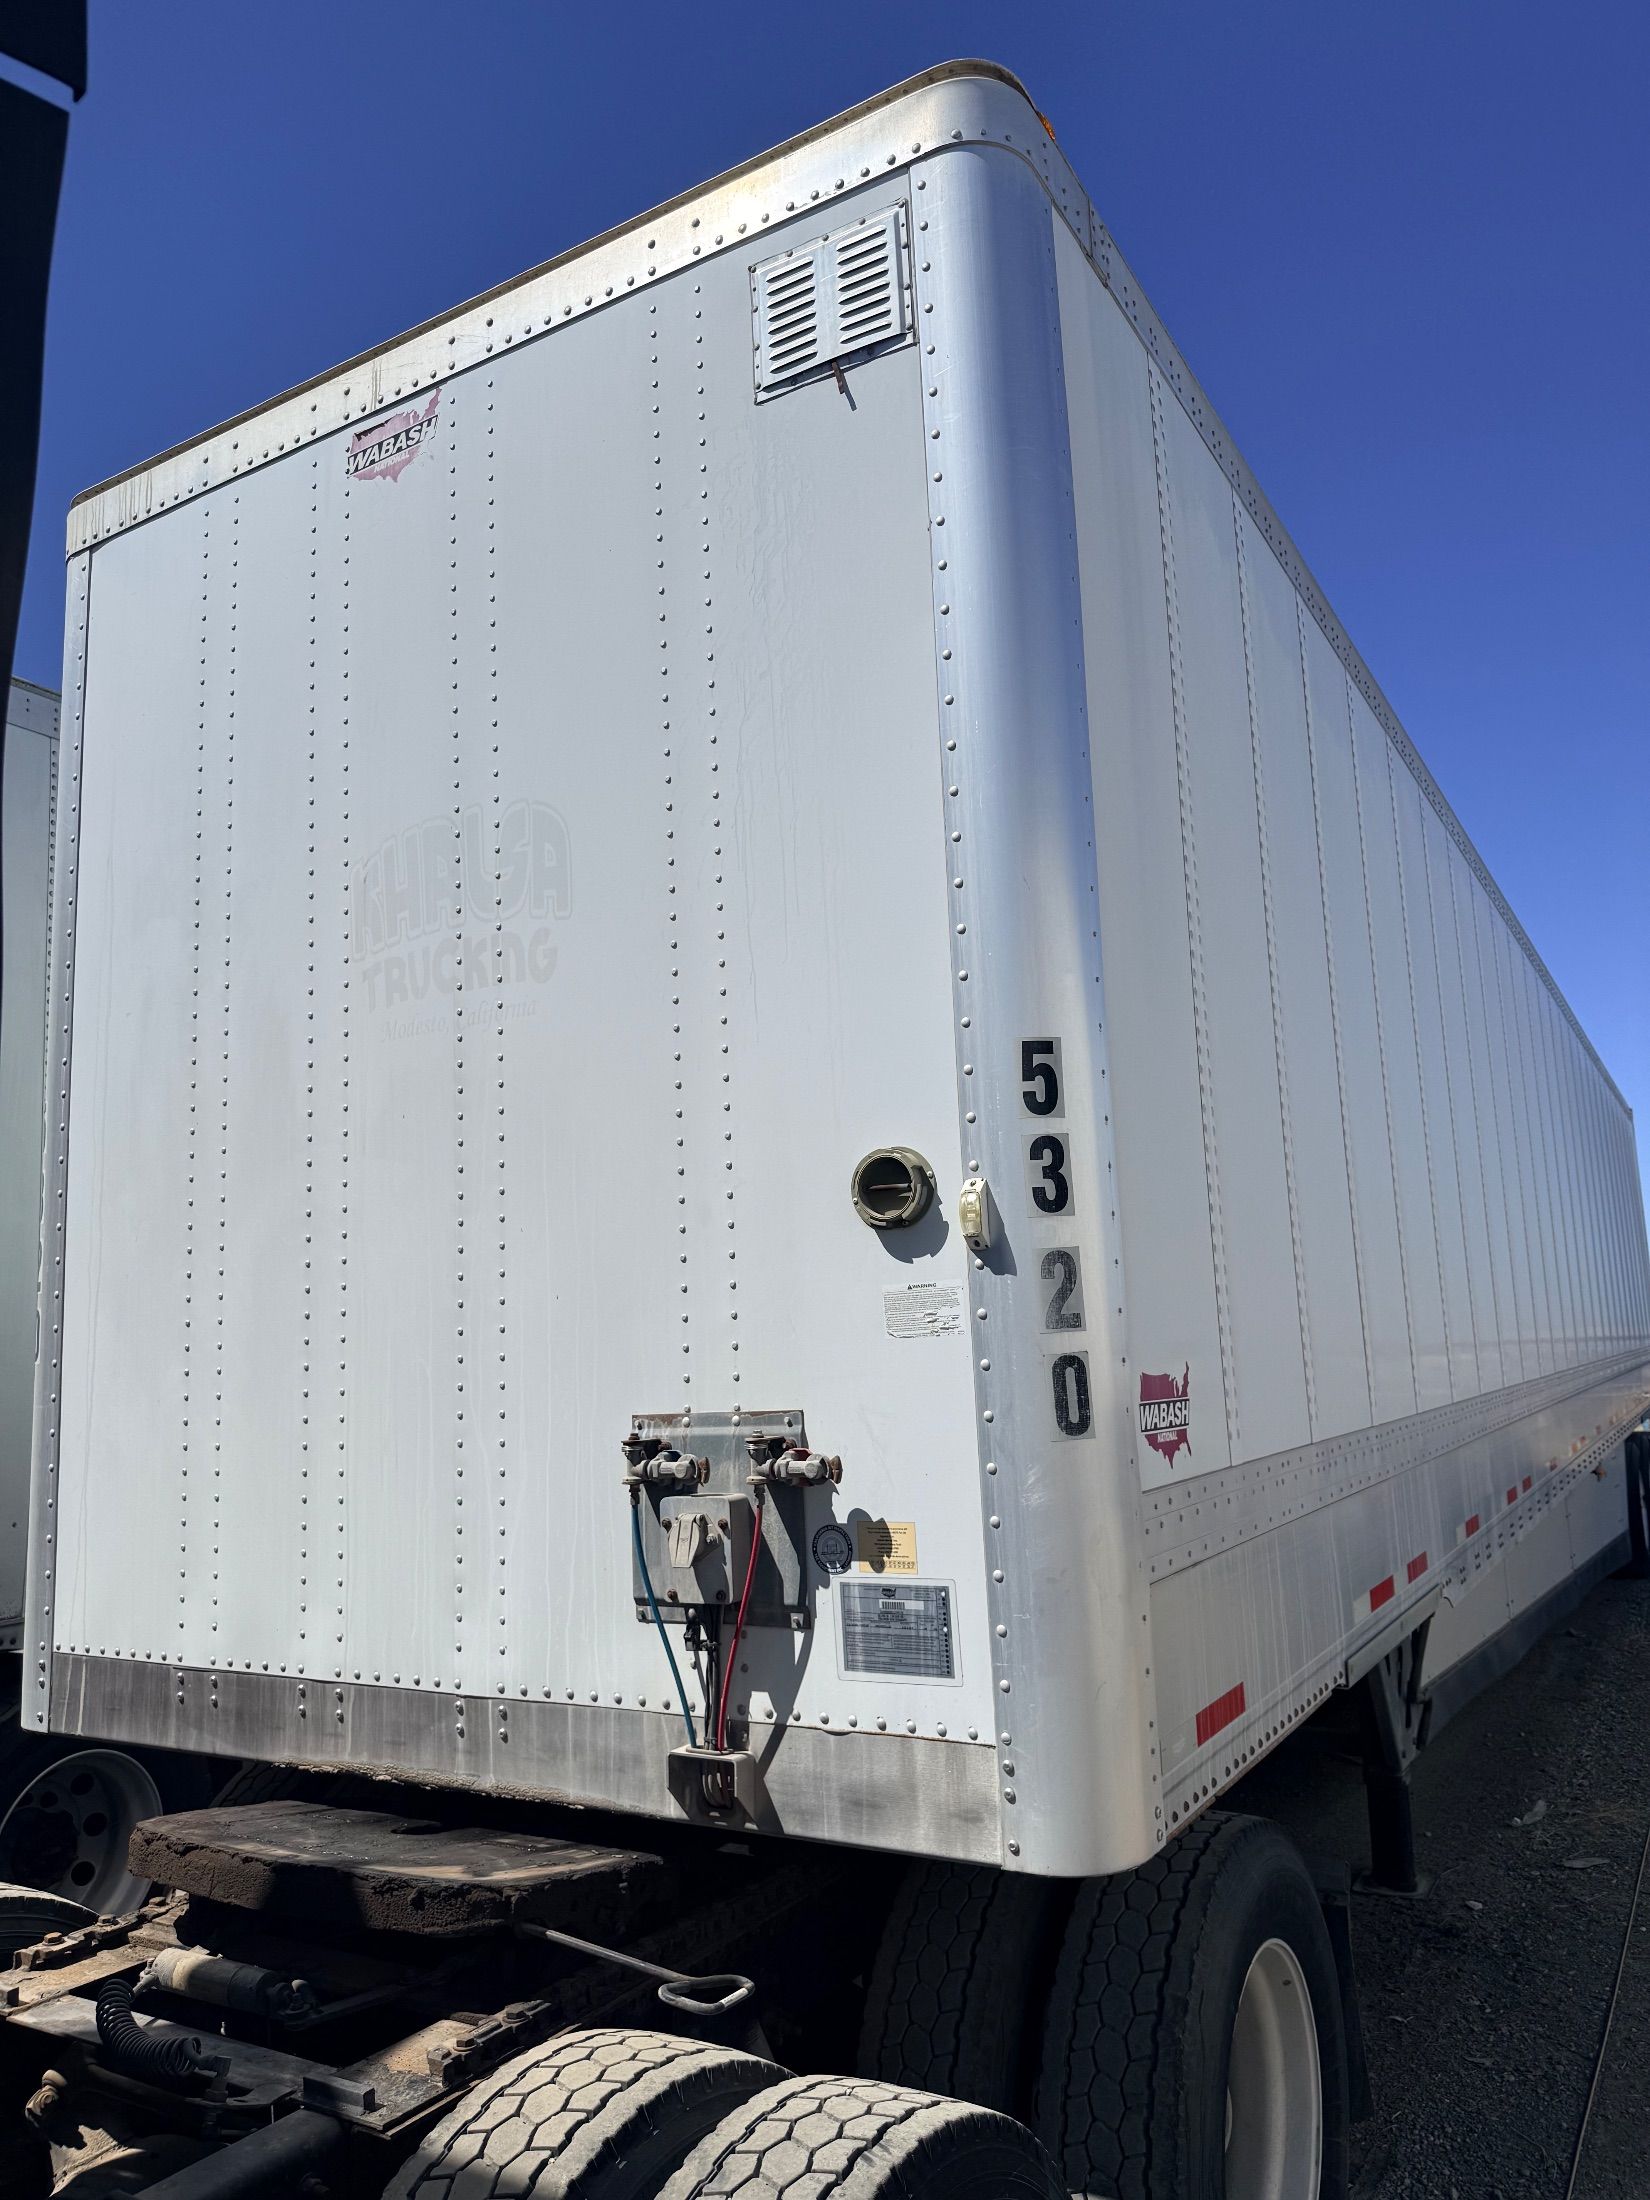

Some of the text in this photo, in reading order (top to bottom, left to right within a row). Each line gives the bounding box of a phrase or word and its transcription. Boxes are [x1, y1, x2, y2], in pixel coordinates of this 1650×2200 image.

[349, 415, 438, 474] WABASH
[351, 798, 573, 962] KHALSA
[361, 927, 558, 1014] TRUCKING
[1140, 1401, 1189, 1431] WABASH
[1157, 1430, 1178, 1443] NATIONAL
